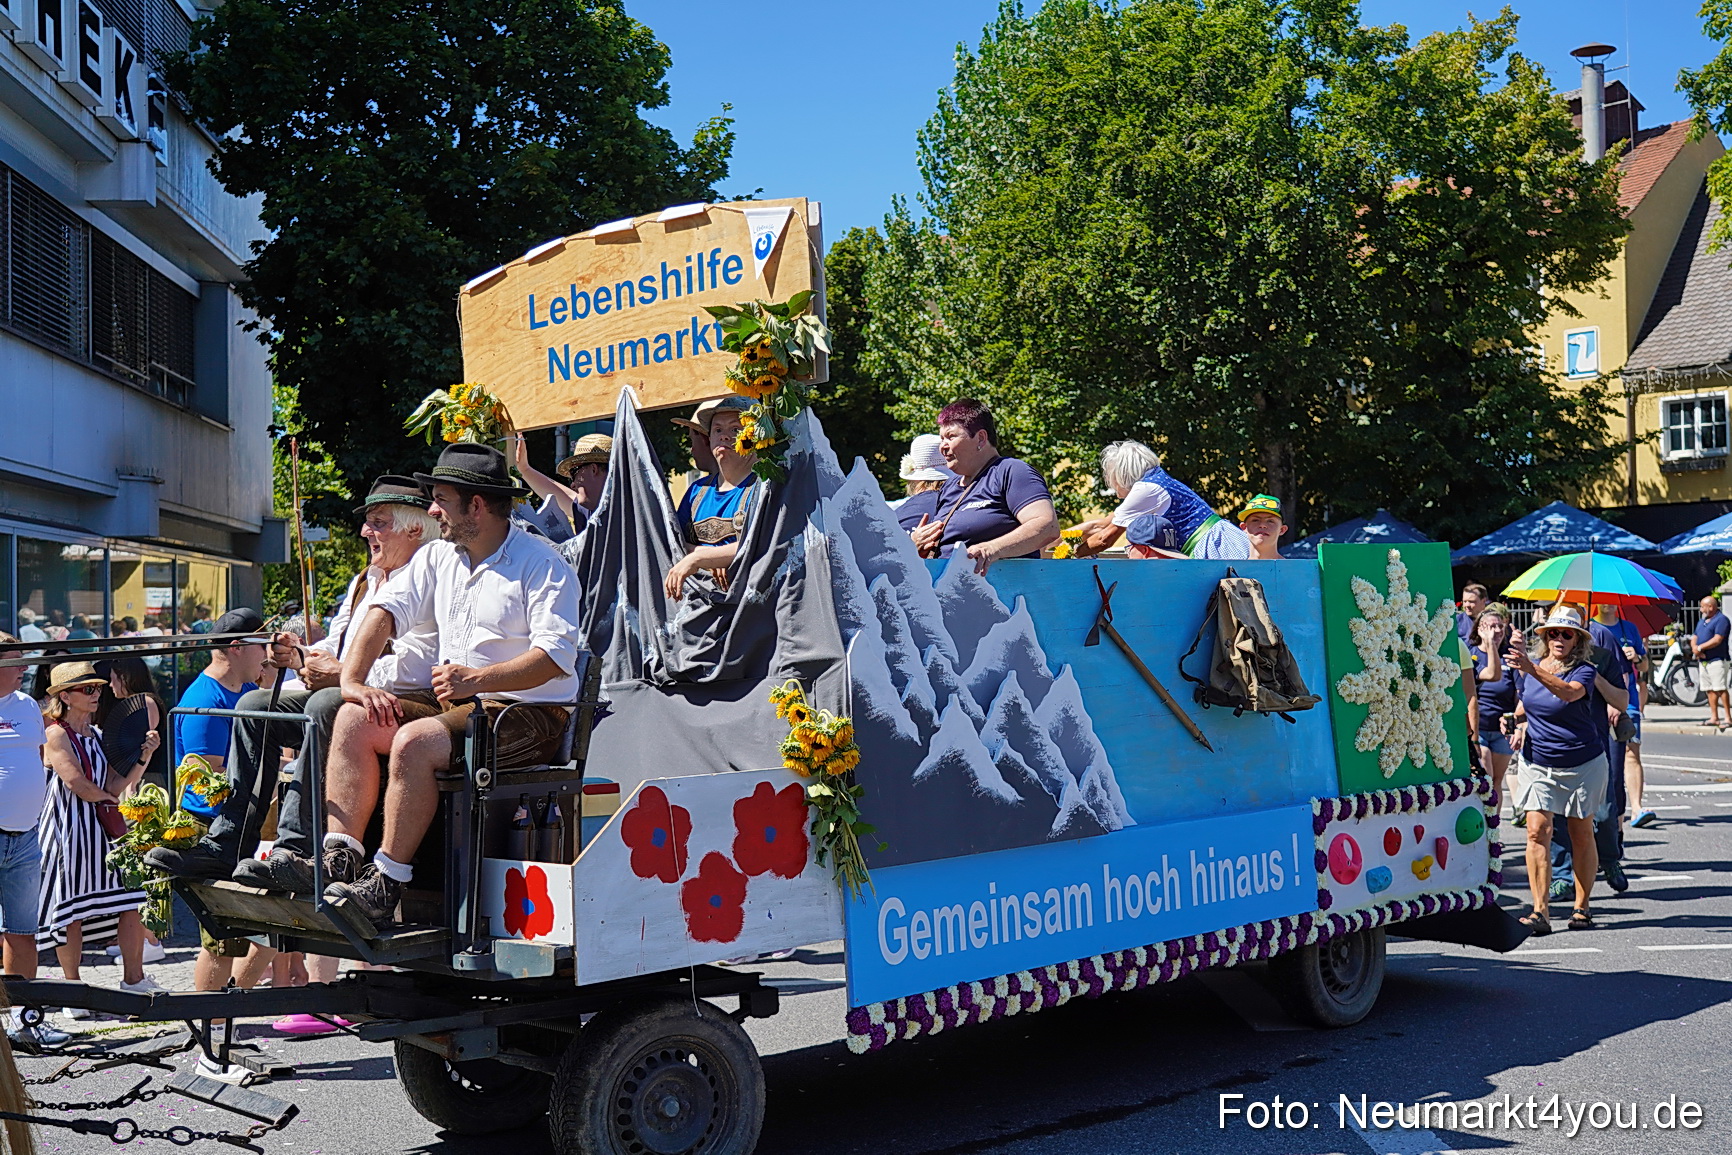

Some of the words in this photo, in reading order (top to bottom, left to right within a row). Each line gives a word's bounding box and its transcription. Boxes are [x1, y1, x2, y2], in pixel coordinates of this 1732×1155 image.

[529, 247, 744, 330] Lebenshilfe
[548, 315, 724, 384] Neumarkt
[1162, 528, 1175, 547] N
[877, 882, 1094, 966] Gemeinsam
[1102, 853, 1182, 924] hoch
[1189, 846, 1285, 907] hinaus
[1291, 833, 1301, 887] !
